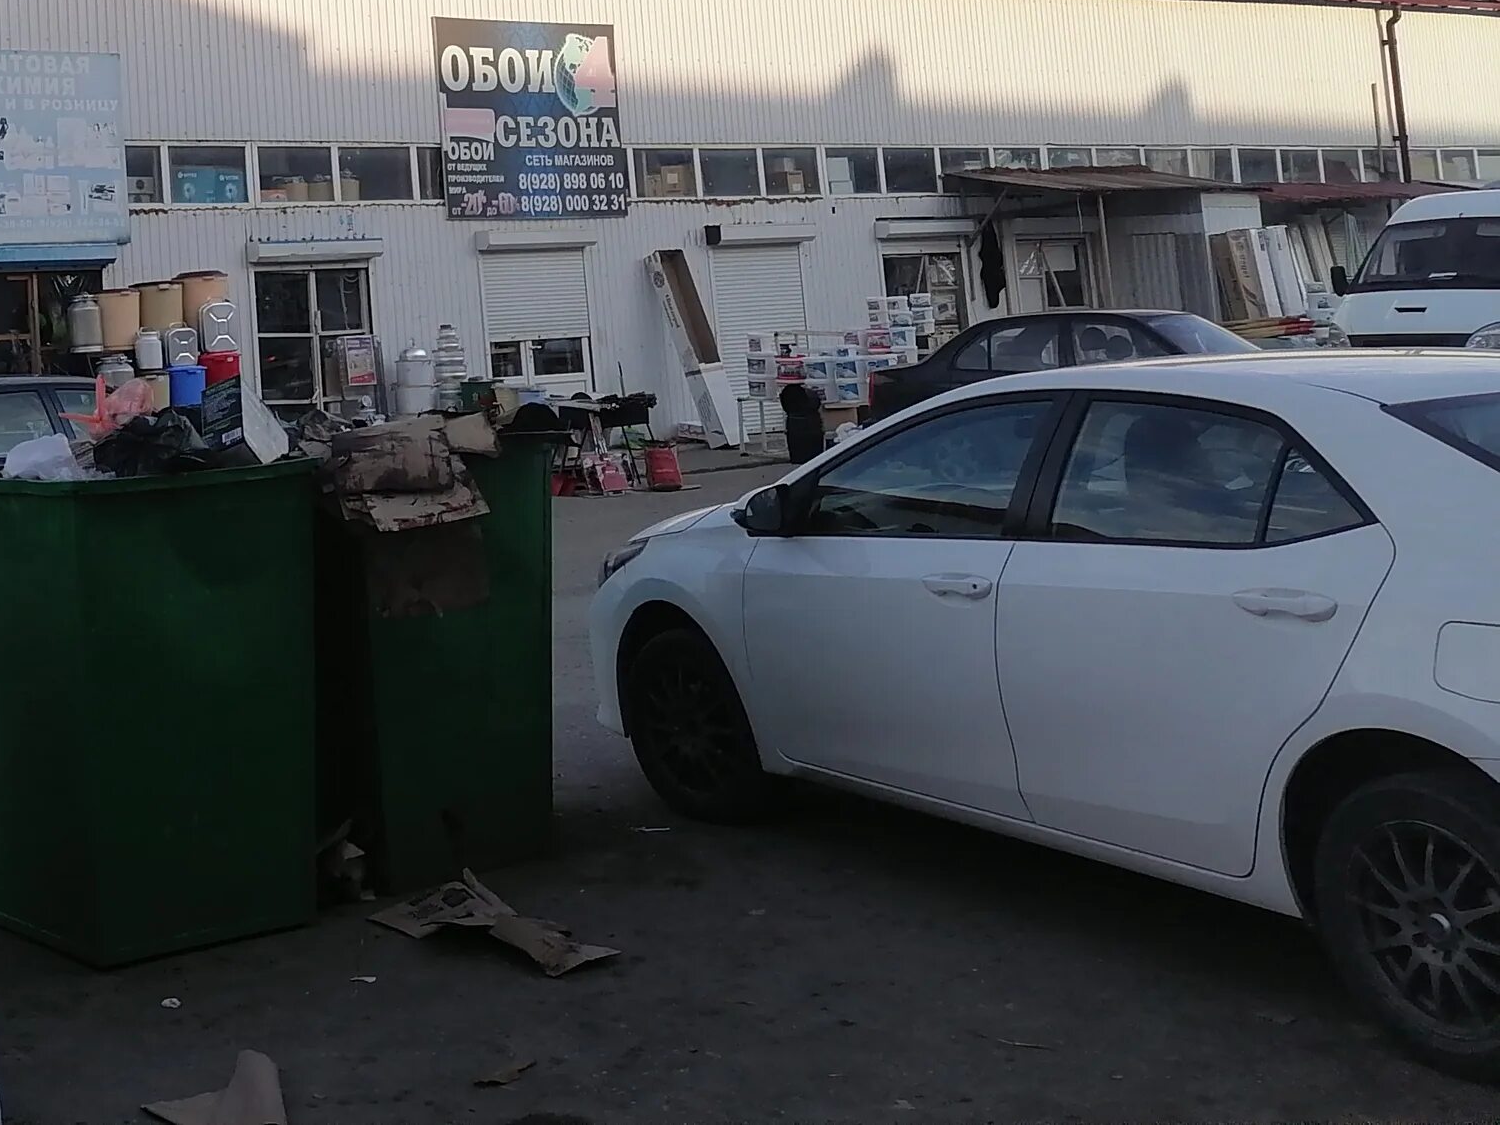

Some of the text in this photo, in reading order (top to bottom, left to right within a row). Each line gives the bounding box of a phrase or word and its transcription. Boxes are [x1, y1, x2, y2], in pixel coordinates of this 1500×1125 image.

[441, 44, 556, 93] ОБОИ
[4, 98, 16, 110] И
[23, 98, 35, 110] В
[41, 99, 119, 112] РОЗНИЦУ
[496, 115, 622, 149] СЕЗОНА
[448, 141, 495, 161] ОБОИ
[525, 154, 615, 167] СЕТЬ МАГАЗИНОВ
[518, 172, 624, 194] 8(928) 898 06 10
[521, 193, 626, 216] 8(928) 000 32 31
